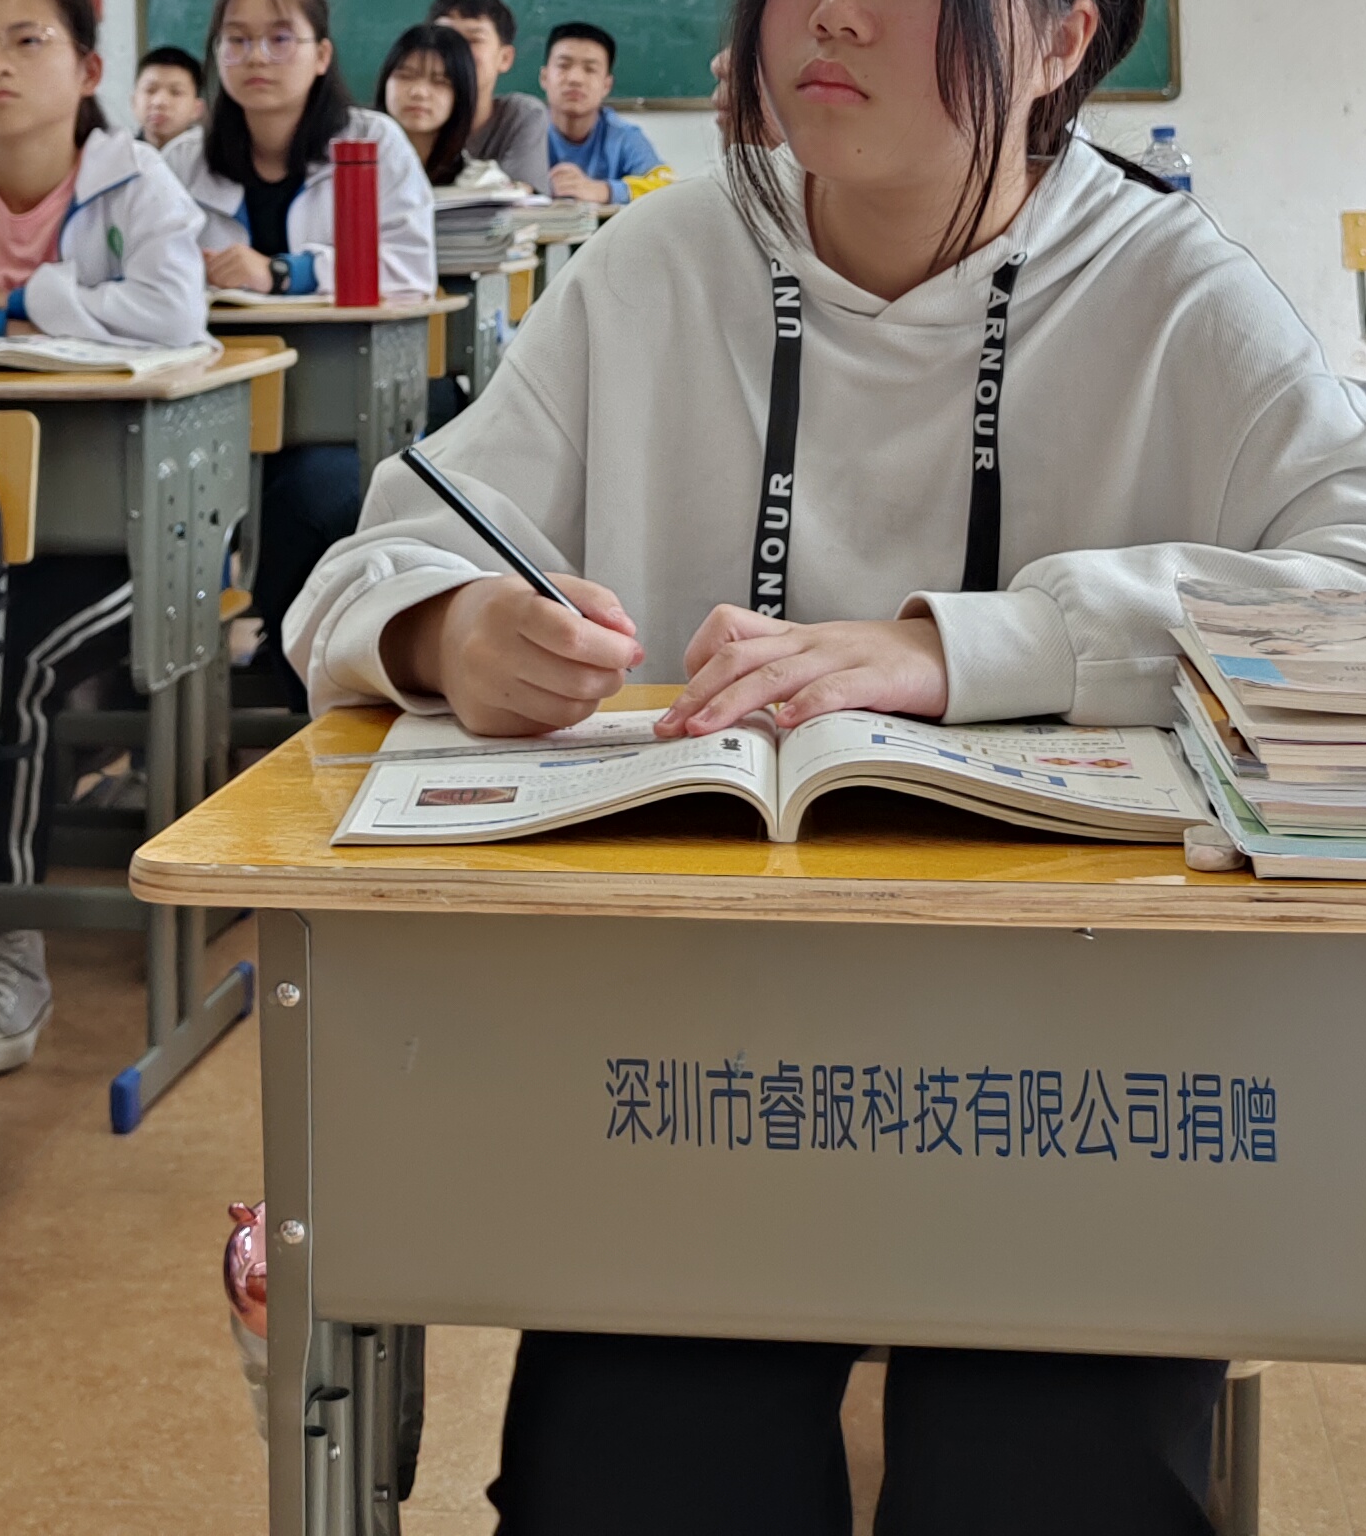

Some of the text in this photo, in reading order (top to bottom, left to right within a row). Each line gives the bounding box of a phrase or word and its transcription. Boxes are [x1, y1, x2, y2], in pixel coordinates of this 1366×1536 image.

[973, 285, 1010, 471] ARNOUR
[606, 1058, 1278, 1163] 深圳市睿服科技有限公司捐赠
